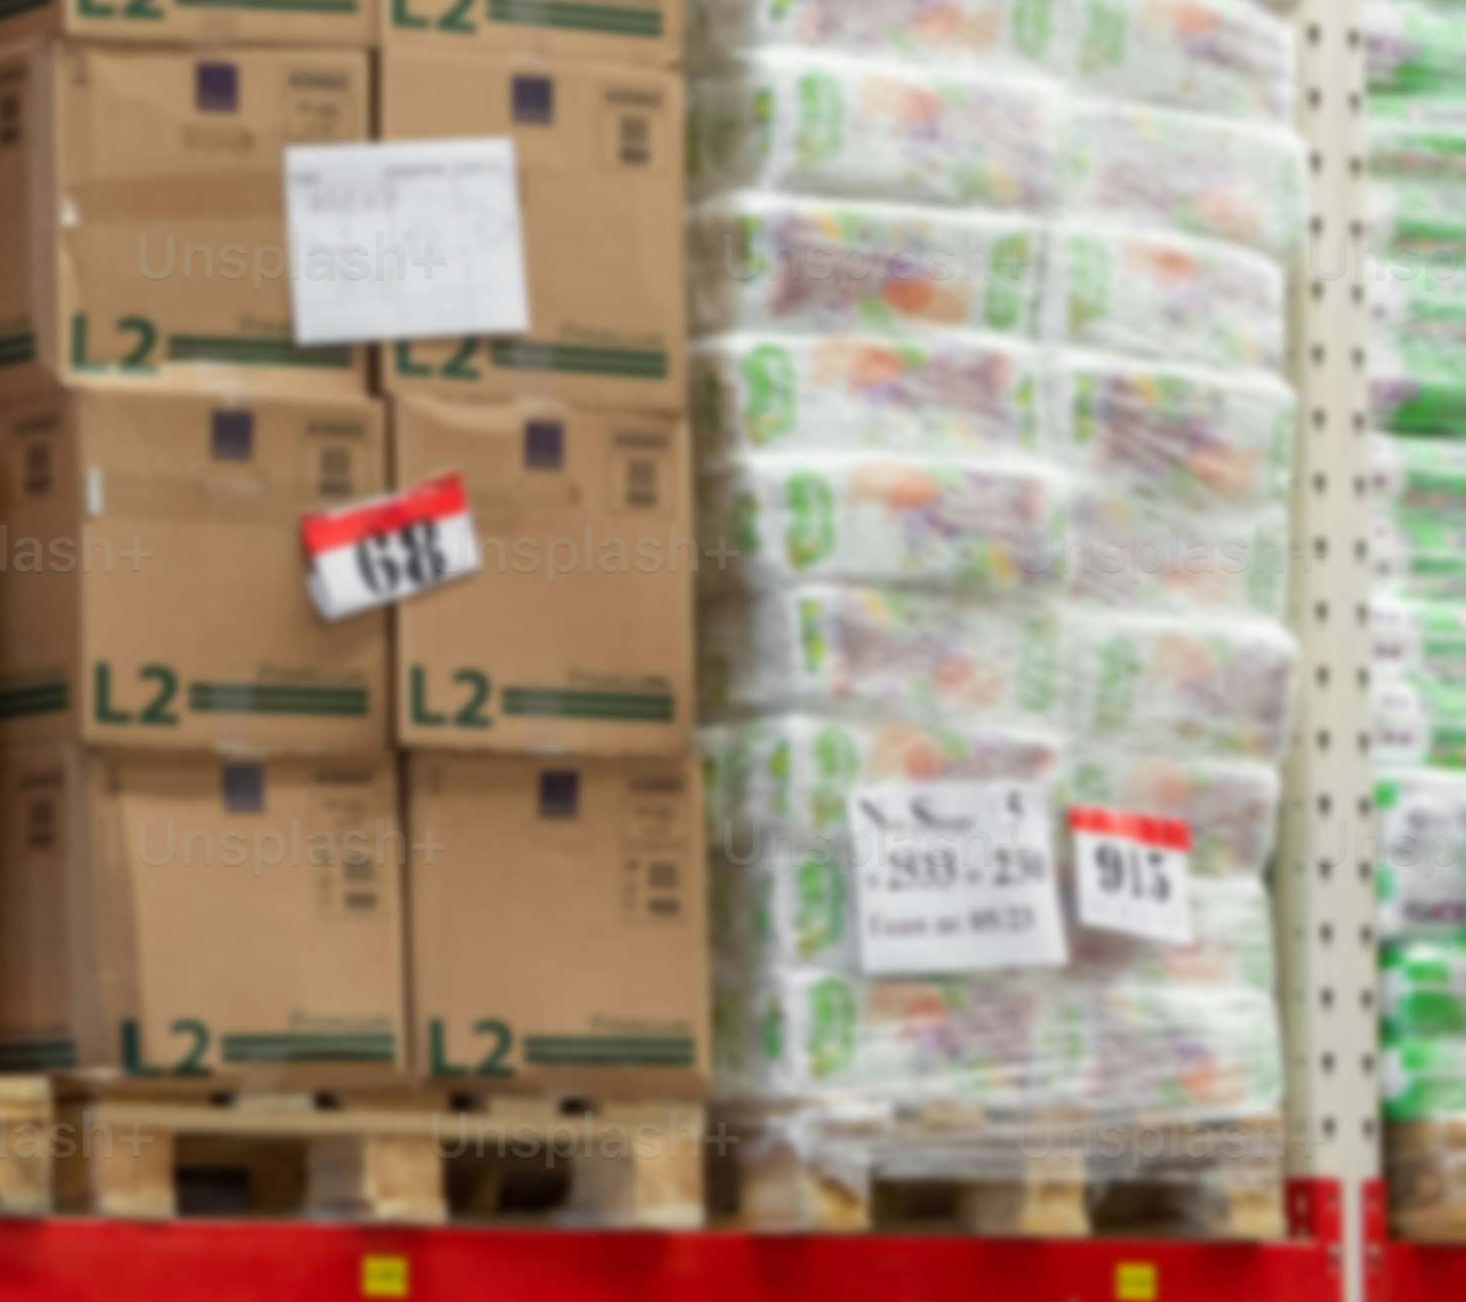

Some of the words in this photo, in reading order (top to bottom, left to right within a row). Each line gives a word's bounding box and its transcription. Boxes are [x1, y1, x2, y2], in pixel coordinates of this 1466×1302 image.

[70, 312, 160, 375] L2
[94, 661, 179, 726] L2
[410, 666, 494, 728] L2
[122, 1018, 214, 1077] L2
[430, 1018, 515, 1078] L2
